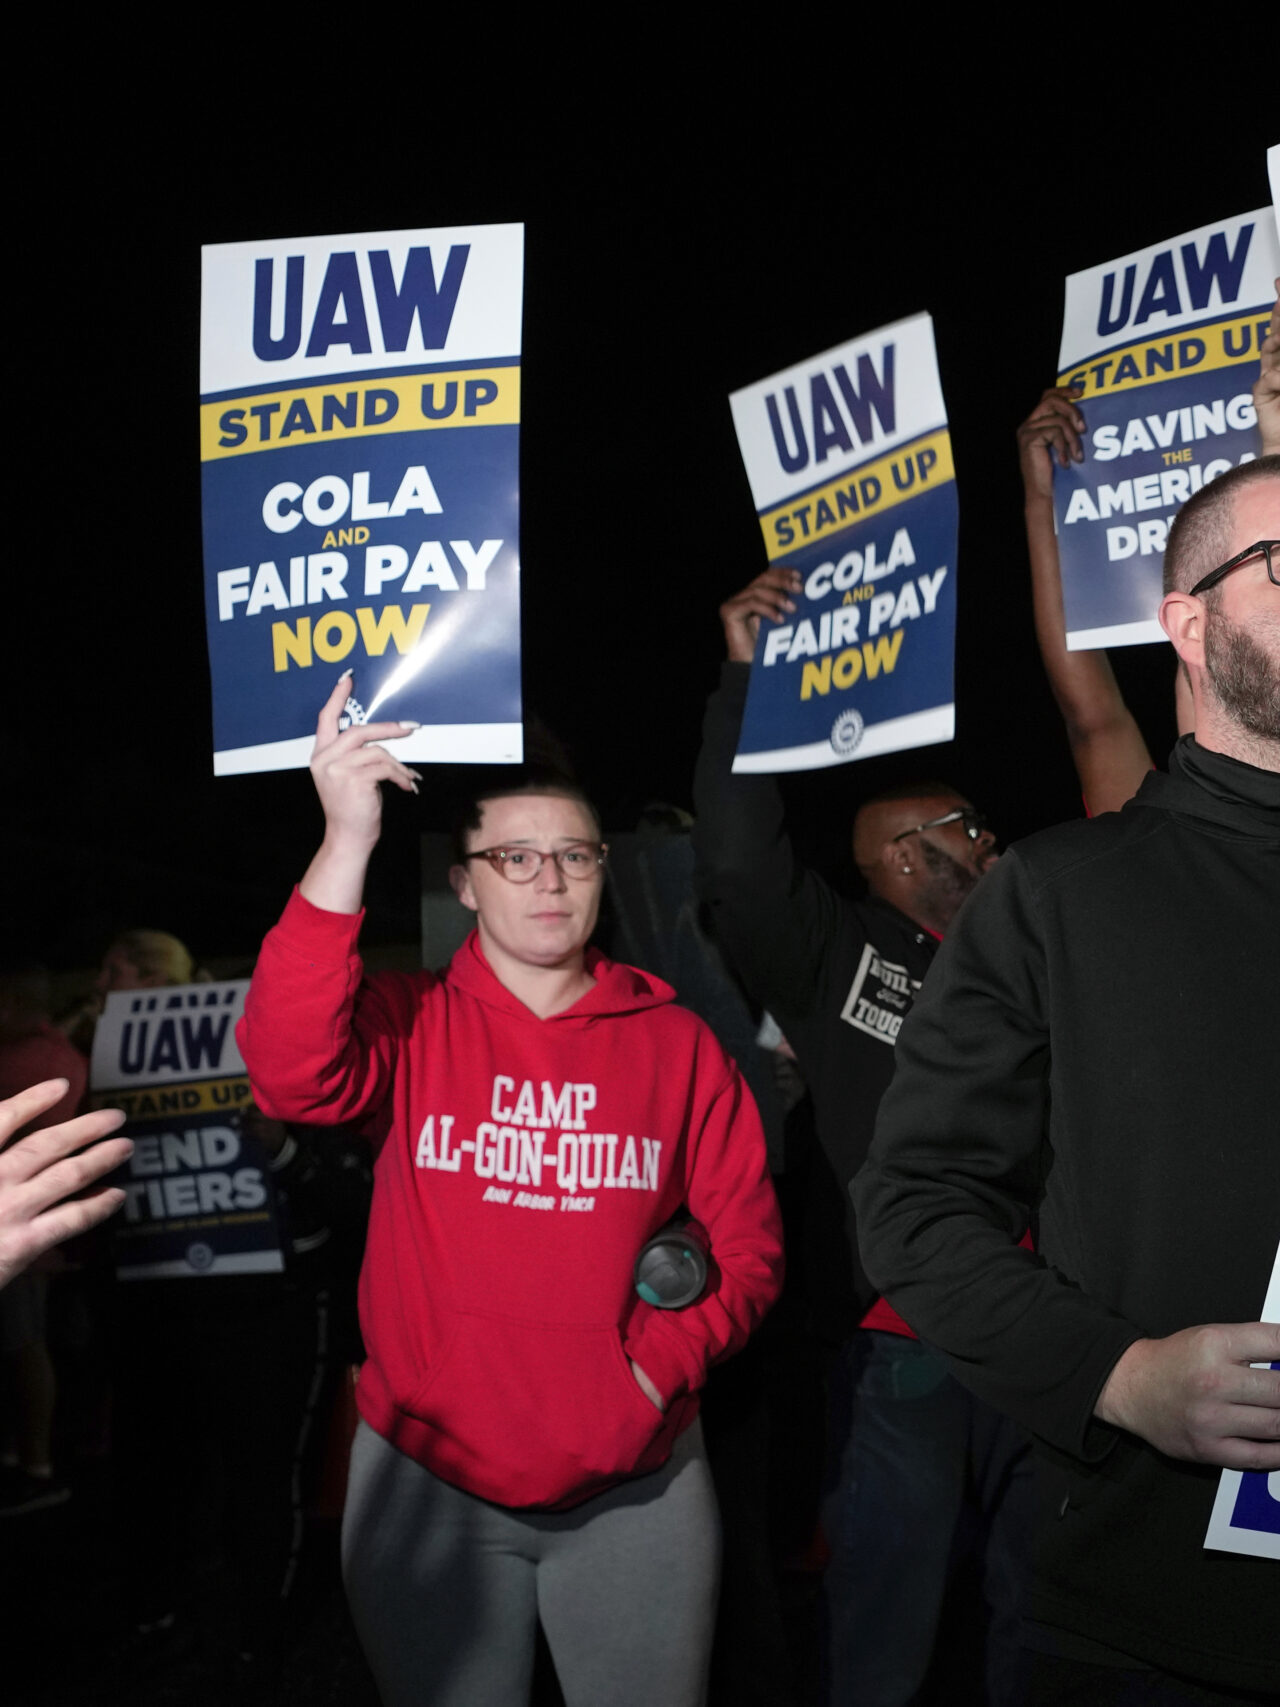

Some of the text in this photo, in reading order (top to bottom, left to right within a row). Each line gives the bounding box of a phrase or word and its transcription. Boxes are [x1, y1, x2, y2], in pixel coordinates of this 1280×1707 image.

[253, 244, 471, 362] UAW
[1097, 222, 1256, 338] UAW
[1069, 338, 1206, 391] STAND
[217, 379, 499, 449] STAND UP
[765, 342, 896, 475] UAW
[1093, 393, 1258, 461] SAVING
[1162, 448, 1192, 466] THE
[262, 466, 443, 534] COLA
[774, 447, 937, 548] STAND UP
[322, 527, 370, 548] AND
[804, 528, 915, 601] COLA
[217, 539, 504, 621] FAIR PAY
[843, 584, 875, 605] AND
[272, 603, 431, 673] NOW
[763, 566, 948, 667] FAIR PAY
[800, 629, 904, 701] NOW
[121, 1014, 231, 1074] UAW
[856, 997, 904, 1038] TOUG
[212, 1083, 250, 1105] UP
[491, 1074, 597, 1130] CAMP
[130, 1125, 240, 1175] END
[415, 1114, 662, 1195] AL-GON-QUIAN
[121, 1167, 267, 1221] TIERS
